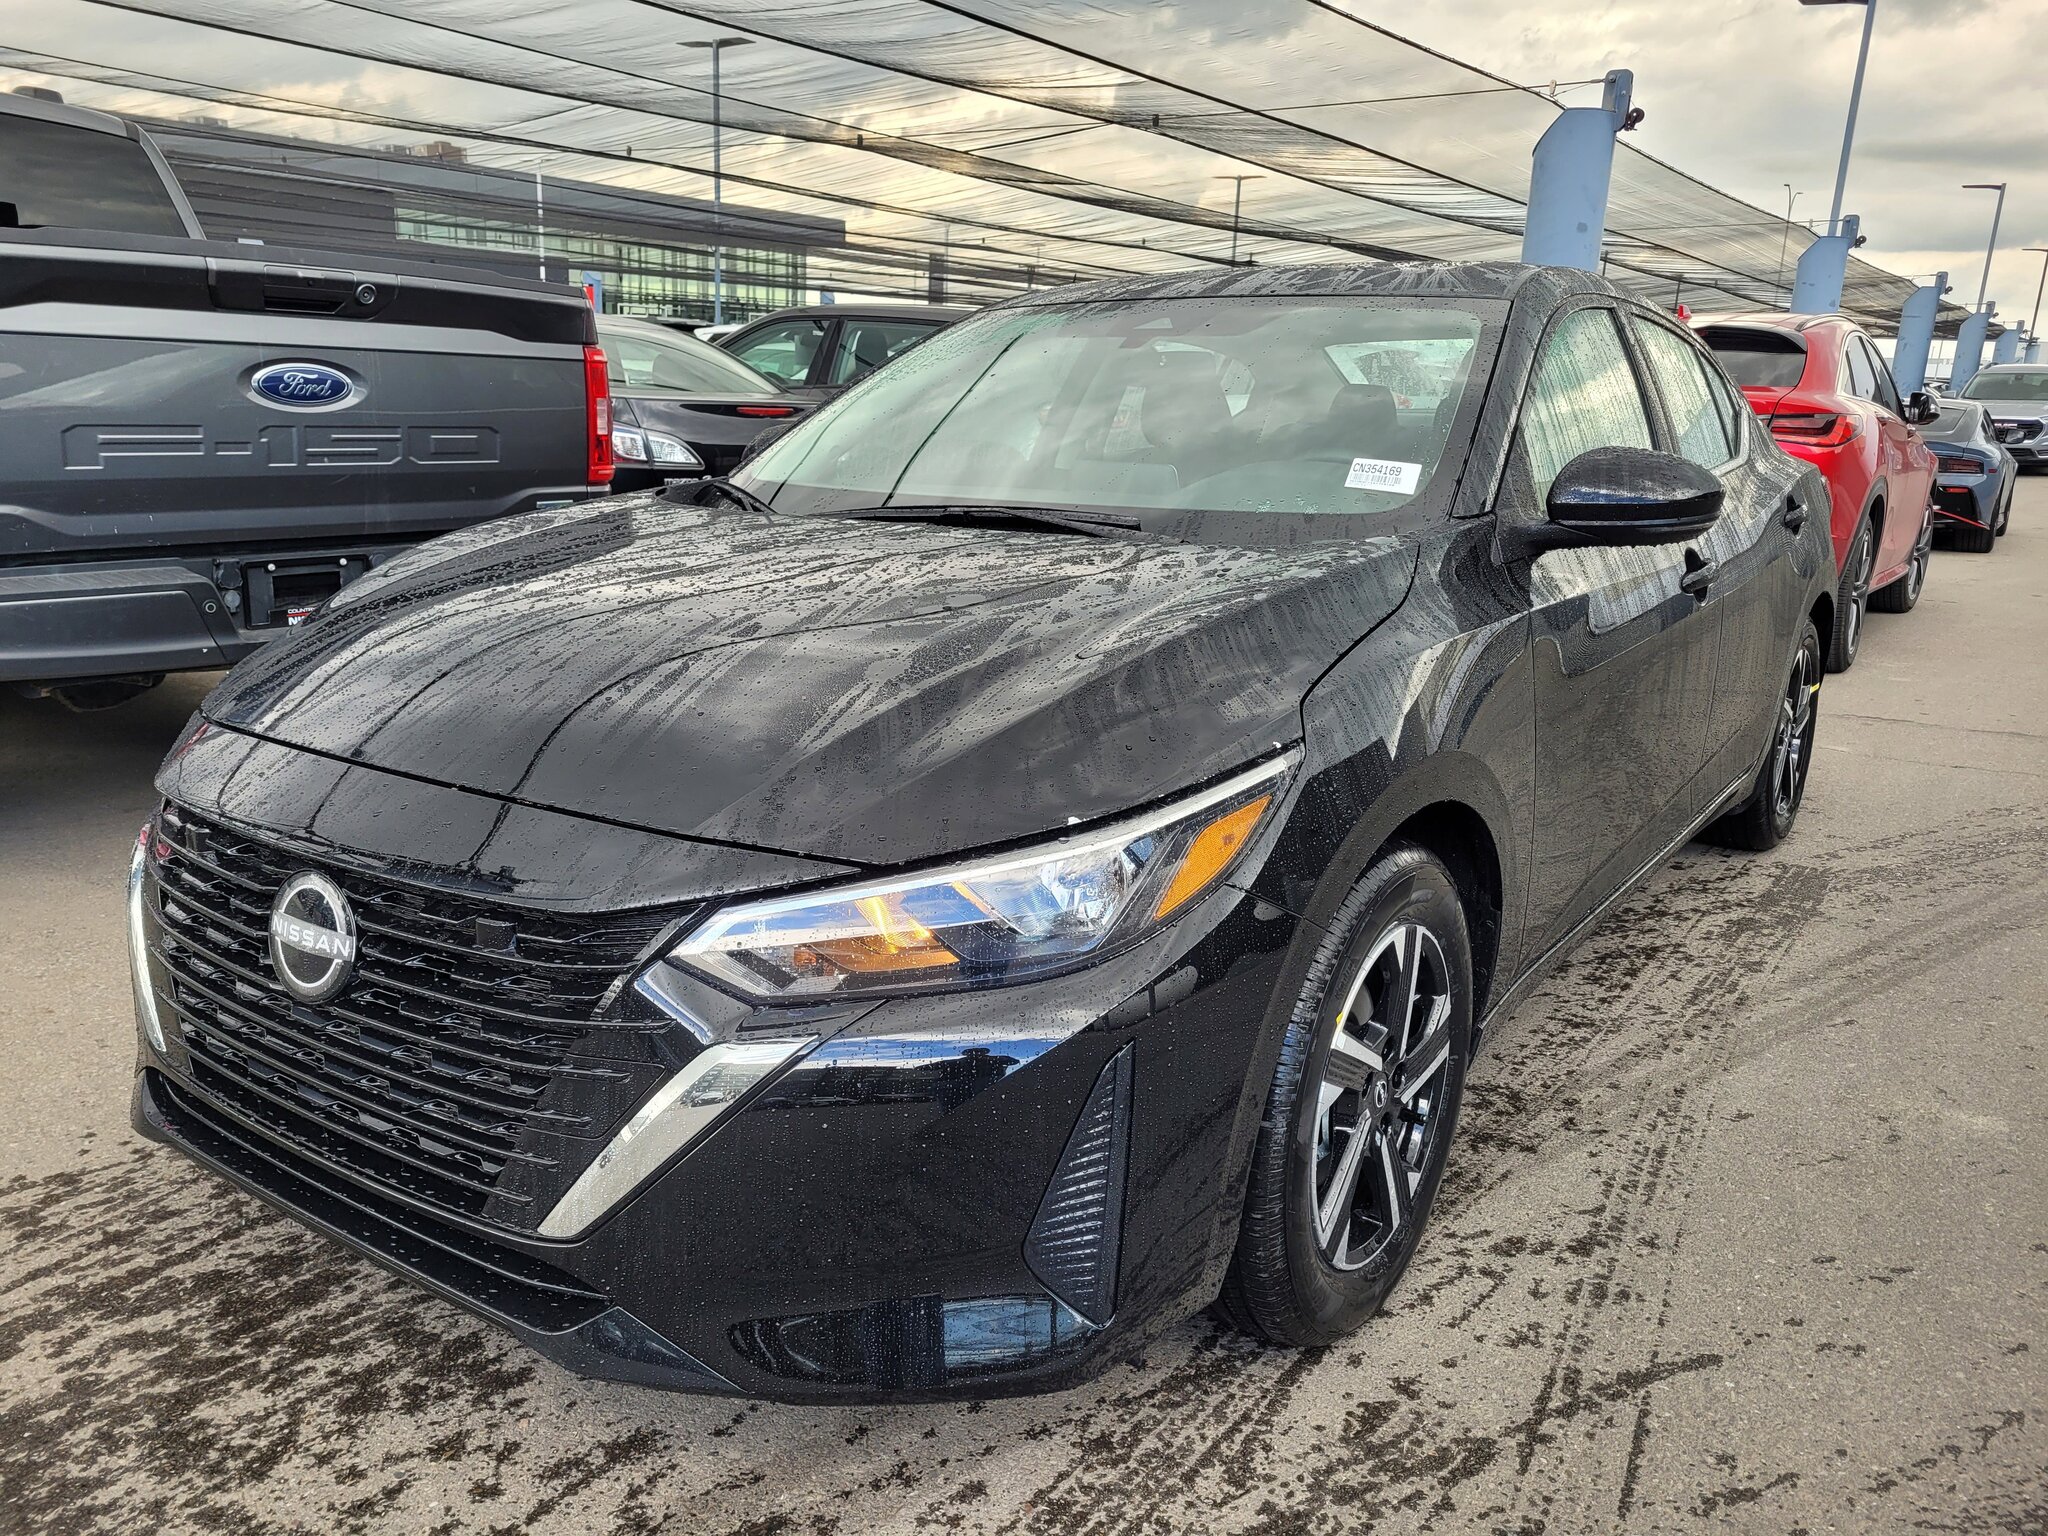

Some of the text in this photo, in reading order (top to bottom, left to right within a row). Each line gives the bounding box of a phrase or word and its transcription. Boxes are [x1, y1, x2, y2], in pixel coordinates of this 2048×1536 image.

[279, 372, 332, 396] Ford
[61, 424, 499, 470] F-150
[1353, 463, 1402, 476] CN354169
[272, 914, 351, 957] NISSAN
